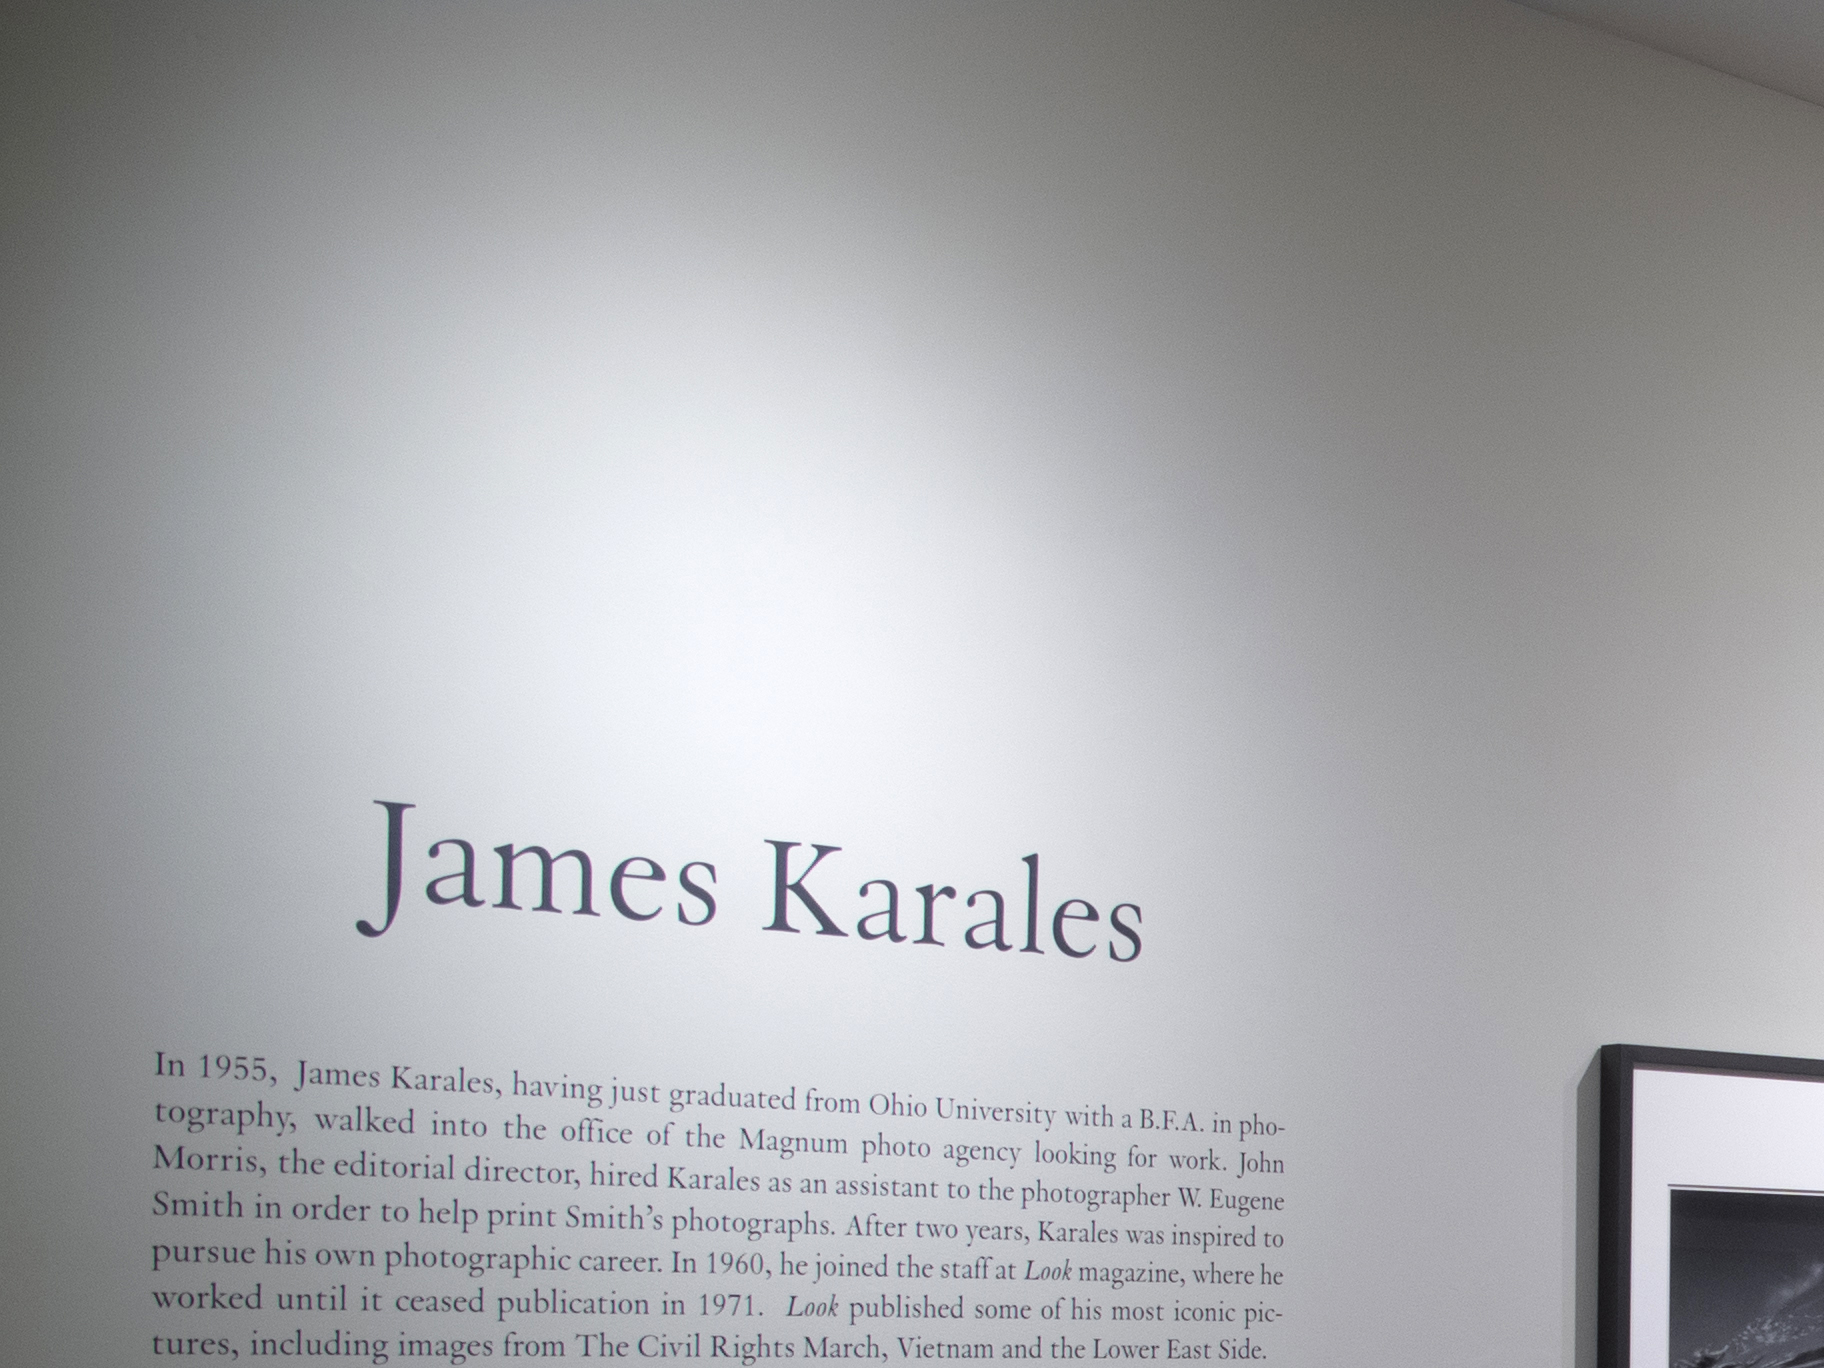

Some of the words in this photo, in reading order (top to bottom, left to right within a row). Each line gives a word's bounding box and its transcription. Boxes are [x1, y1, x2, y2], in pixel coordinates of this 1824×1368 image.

[356, 800, 717, 938] James
[763, 840, 1143, 963] Karales
[156, 1051, 184, 1077] In
[201, 1054, 277, 1086] 1955,
[293, 1060, 380, 1092] James
[392, 1065, 502, 1098] Karales,
[513, 1070, 603, 1108] having
[609, 1077, 659, 1109] just
[670, 1082, 796, 1112] graduated
[806, 1088, 860, 1113] from
[869, 1092, 927, 1116] Ohio
[937, 1097, 1056, 1132] University
[1066, 1104, 1113, 1127] with
[1122, 1114, 1132, 1128] a
[1141, 1108, 1204, 1132] B.F.A.
[1213, 1112, 1231, 1133] in
[1239, 1113, 1285, 1142] pho-
[156, 1100, 297, 1137] tography,
[315, 1105, 414, 1134] walked
[432, 1111, 487, 1137] into
[504, 1113, 547, 1140] the
[561, 1117, 632, 1144] office
[647, 1122, 675, 1146] of
[686, 1123, 725, 1148] the
[740, 1128, 847, 1159] Magnum
[862, 1132, 931, 1163] photo
[944, 1144, 1021, 1169] agency
[1036, 1140, 1116, 1173] looking
[1128, 1144, 1157, 1168] for
[1169, 1148, 1226, 1171] work.
[1237, 1150, 1284, 1179] John
[154, 1144, 266, 1177] Morris,
[279, 1147, 325, 1175] the
[334, 1150, 454, 1180] editorial
[464, 1155, 580, 1188] director,
[591, 1160, 658, 1188] hired
[668, 1166, 760, 1191] Karales
[769, 1177, 791, 1192] as
[800, 1179, 827, 1194] an
[836, 1174, 938, 1198] assistant
[948, 1183, 970, 1199] to
[979, 1177, 1014, 1201] the
[1022, 1179, 1171, 1213] photographer
[1178, 1187, 1201, 1207] W.
[1210, 1188, 1284, 1217] Eugene
[153, 1190, 243, 1218] Smith
[256, 1193, 281, 1219] in
[292, 1194, 371, 1221] order
[382, 1204, 409, 1222] to
[420, 1197, 479, 1234] help
[488, 1202, 556, 1234] print
[672, 1206, 835, 1242] photographs.
[846, 1213, 907, 1237] After
[916, 1221, 958, 1238] two
[966, 1225, 1030, 1247] years,
[1039, 1220, 1118, 1243] Karales
[1126, 1230, 1164, 1244] was
[1172, 1224, 1256, 1254] inspired
[1264, 1233, 1284, 1247] to
[152, 1244, 256, 1271] pursue
[265, 1237, 306, 1265] his
[315, 1249, 375, 1266] own
[385, 1241, 571, 1278] photographic
[579, 1256, 662, 1272] career.
[673, 1251, 696, 1273] In
[709, 1252, 772, 1278] 1960,
[781, 1251, 808, 1276] he
[813, 1253, 888, 1284] joined
[897, 1254, 934, 1278] the
[941, 1256, 993, 1279] staff
[995, 1264, 1015, 1280] at
[1024, 1259, 1072, 1280] Look
[1079, 1261, 1185, 1289] magazine,
[1193, 1261, 1254, 1285] where
[1261, 1263, 1283, 1285] he
[152, 1282, 262, 1310] worked
[278, 1284, 346, 1311] until
[362, 1286, 382, 1311] it
[396, 1287, 484, 1313] ceased
[498, 1288, 649, 1322] publication
[663, 1292, 685, 1315] in
[701, 1294, 763, 1316] 1971.
[787, 1294, 839, 1317] Look
[850, 1294, 963, 1326] published
[975, 1304, 1031, 1319] some
[1041, 1297, 1065, 1320] of
[1072, 1297, 1101, 1320] his
[1112, 1305, 1163, 1321] most
[1175, 1300, 1235, 1322] iconic
[1245, 1301, 1282, 1330] pic-
[153, 1336, 239, 1360] tures,
[251, 1329, 389, 1365] including
[399, 1331, 493, 1365] images
[504, 1331, 565, 1357] from
[575, 1332, 629, 1357] The
[638, 1333, 700, 1357] Civil
[711, 1333, 794, 1366] Rights
[804, 1334, 888, 1362] March,
[897, 1336, 993, 1358] Vietnam
[1002, 1335, 1042, 1359] and
[1051, 1336, 1086, 1359] the
[1094, 1338, 1159, 1359] Lower
[1167, 1339, 1210, 1359] East
[1219, 1337, 1266, 1359] Side.
